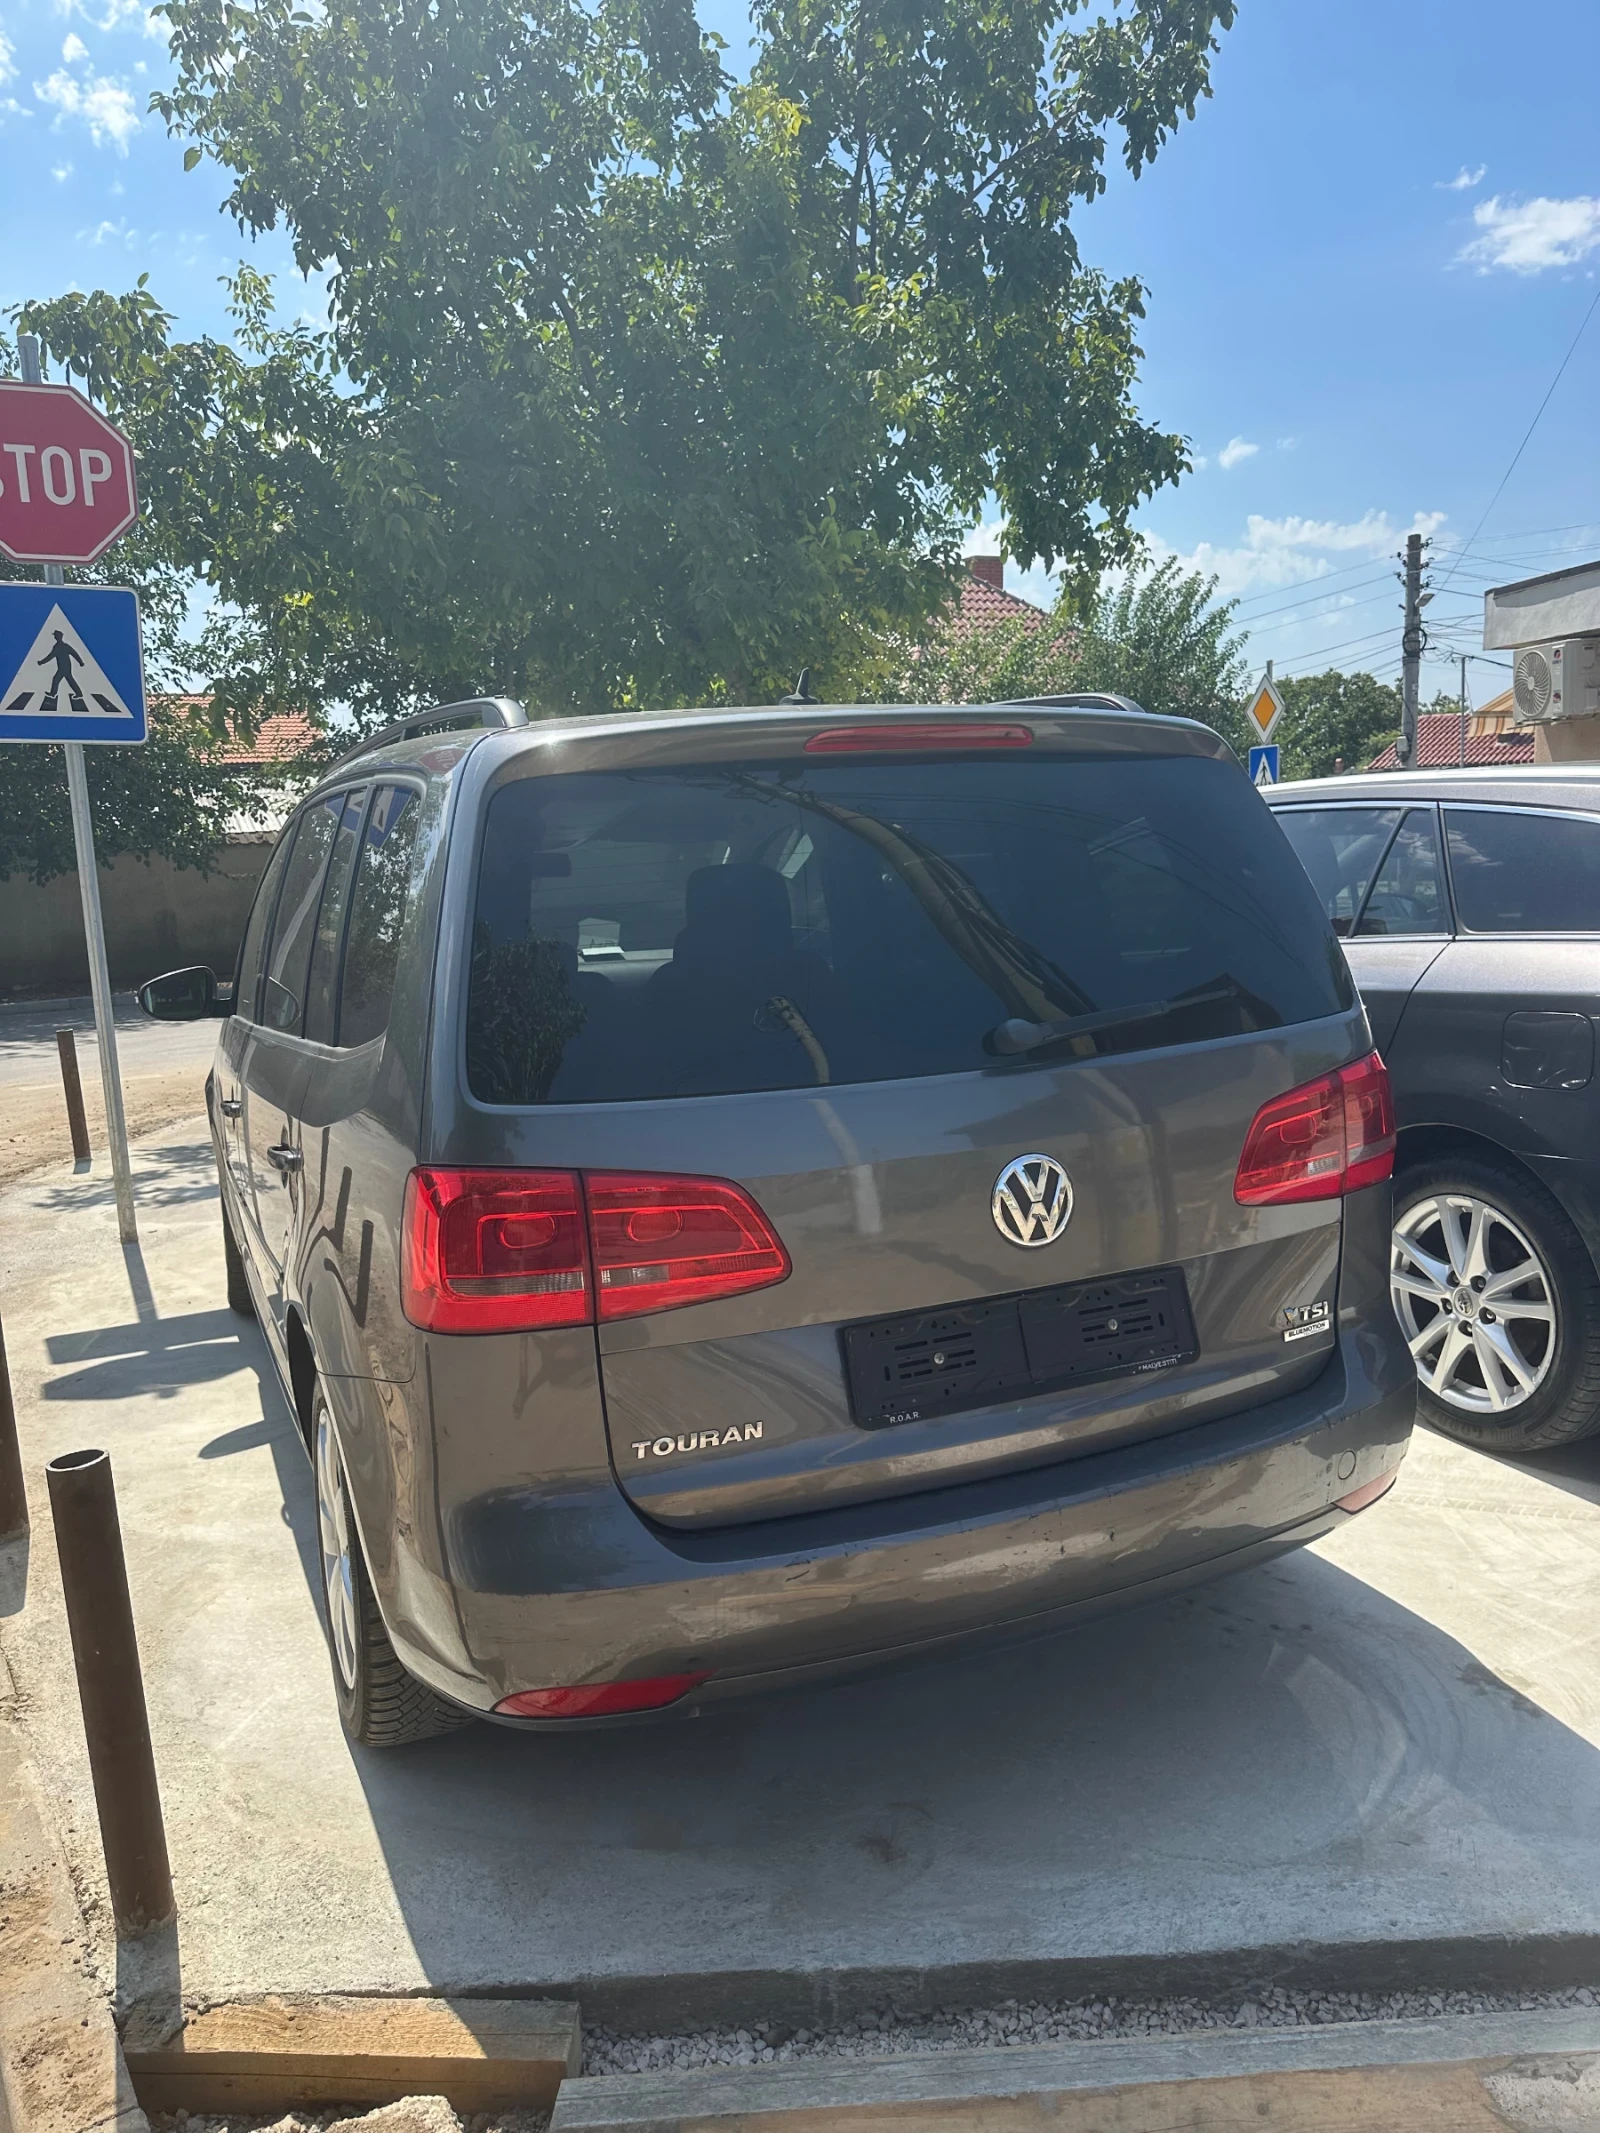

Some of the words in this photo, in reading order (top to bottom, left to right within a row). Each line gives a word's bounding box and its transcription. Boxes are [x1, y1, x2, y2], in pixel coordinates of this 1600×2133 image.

[0, 443, 113, 506] TOP
[1299, 1300, 1329, 1321] TSI
[631, 1421, 763, 1459] TOURAN
